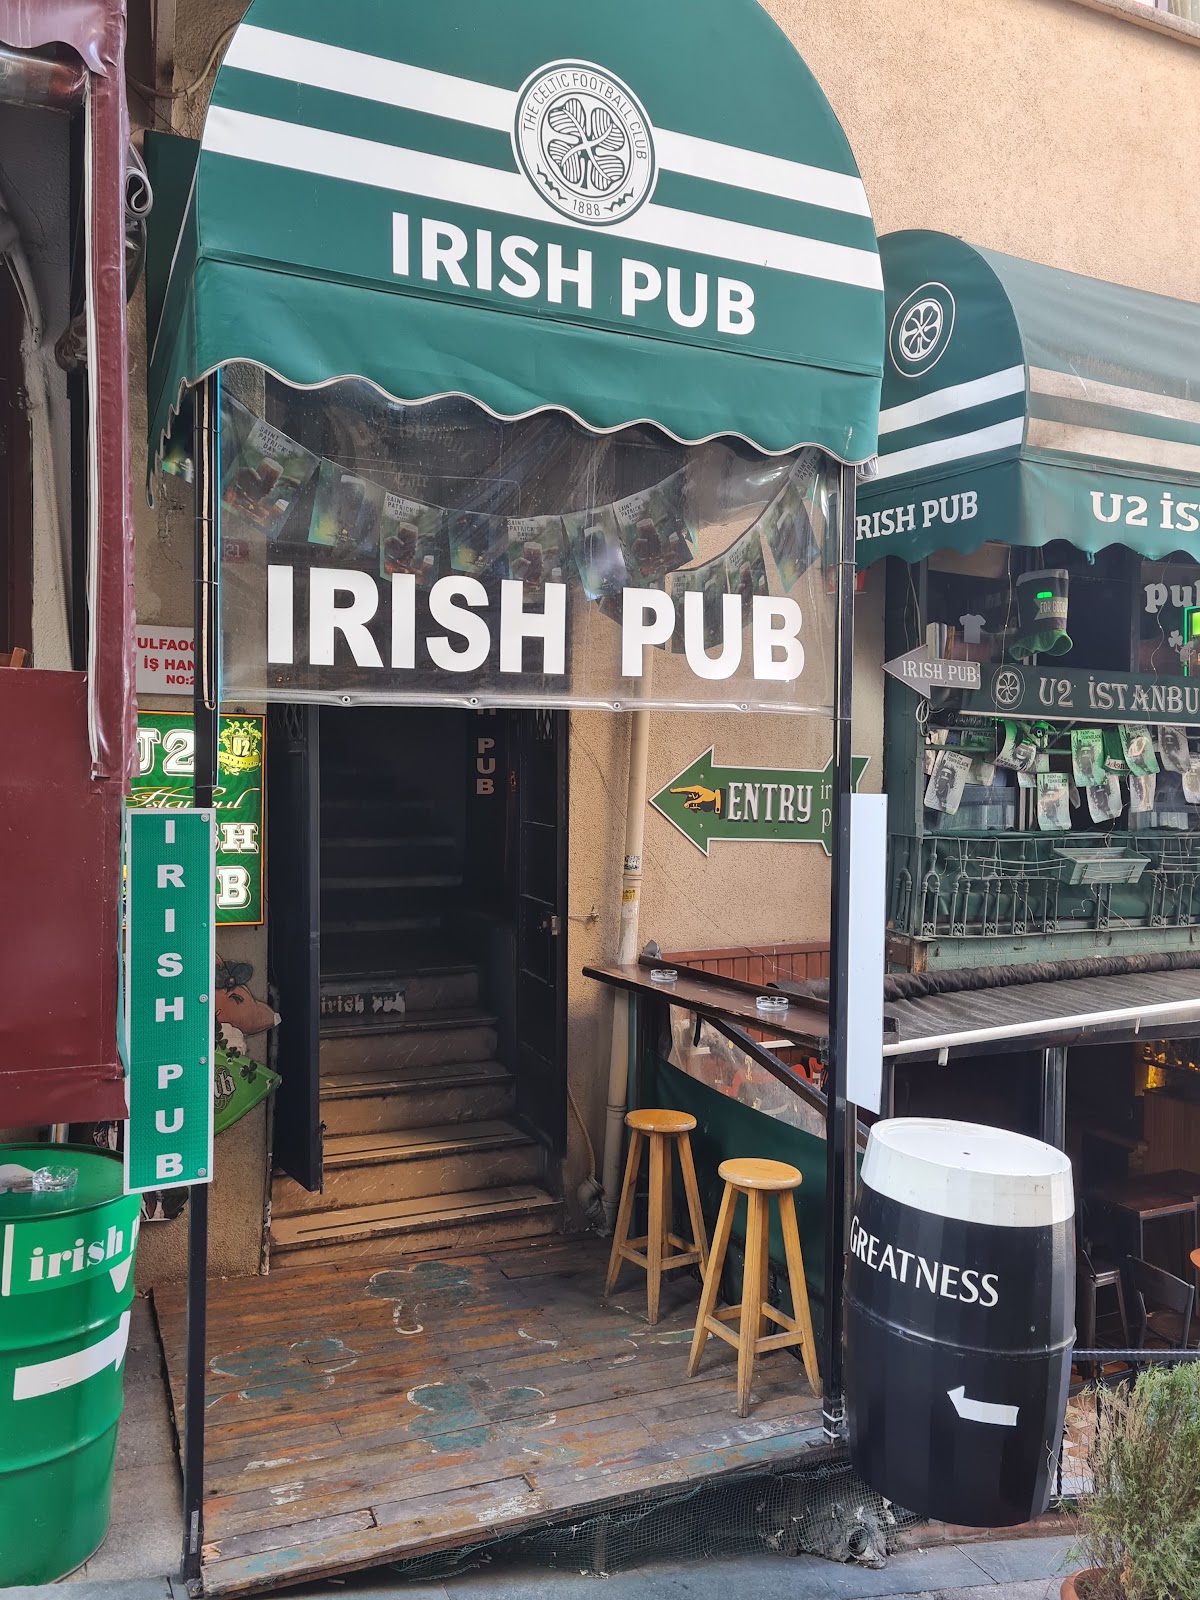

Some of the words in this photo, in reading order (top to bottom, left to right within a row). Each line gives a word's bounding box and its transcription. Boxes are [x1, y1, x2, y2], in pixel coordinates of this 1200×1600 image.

[523, 103, 540, 132] THE
[532, 73, 570, 105] CELTIC
[572, 73, 631, 121] FOOTBALL
[629, 121, 648, 160] CLUB
[573, 199, 601, 216] 1888
[392, 211, 593, 310] IRISH
[621, 257, 756, 336] PUB
[258, 426, 280, 441] SAINT
[386, 495, 405, 505] SAINT
[855, 504, 916, 541] RISH
[922, 490, 978, 528] PUB
[1090, 491, 1148, 527] U2
[1160, 492, 1200, 532] İS
[267, 564, 567, 675] IRISH
[621, 586, 805, 681] PUB
[144, 655, 159, 671] İŞ
[902, 660, 943, 681] IRISH
[948, 664, 977, 683] PUB
[1039, 676, 1073, 708] U2
[1088, 676, 1199, 714] İSTANBU
[234, 737, 251, 756] U2
[476, 737, 496, 795] PUB
[727, 782, 813, 823] ENTRY
[155, 819, 186, 1022] IRISH
[321, 994, 365, 1014] irish
[155, 1063, 185, 1180] PUB
[28, 1224, 124, 1282] irish
[850, 1215, 999, 1308] GREATNESS
